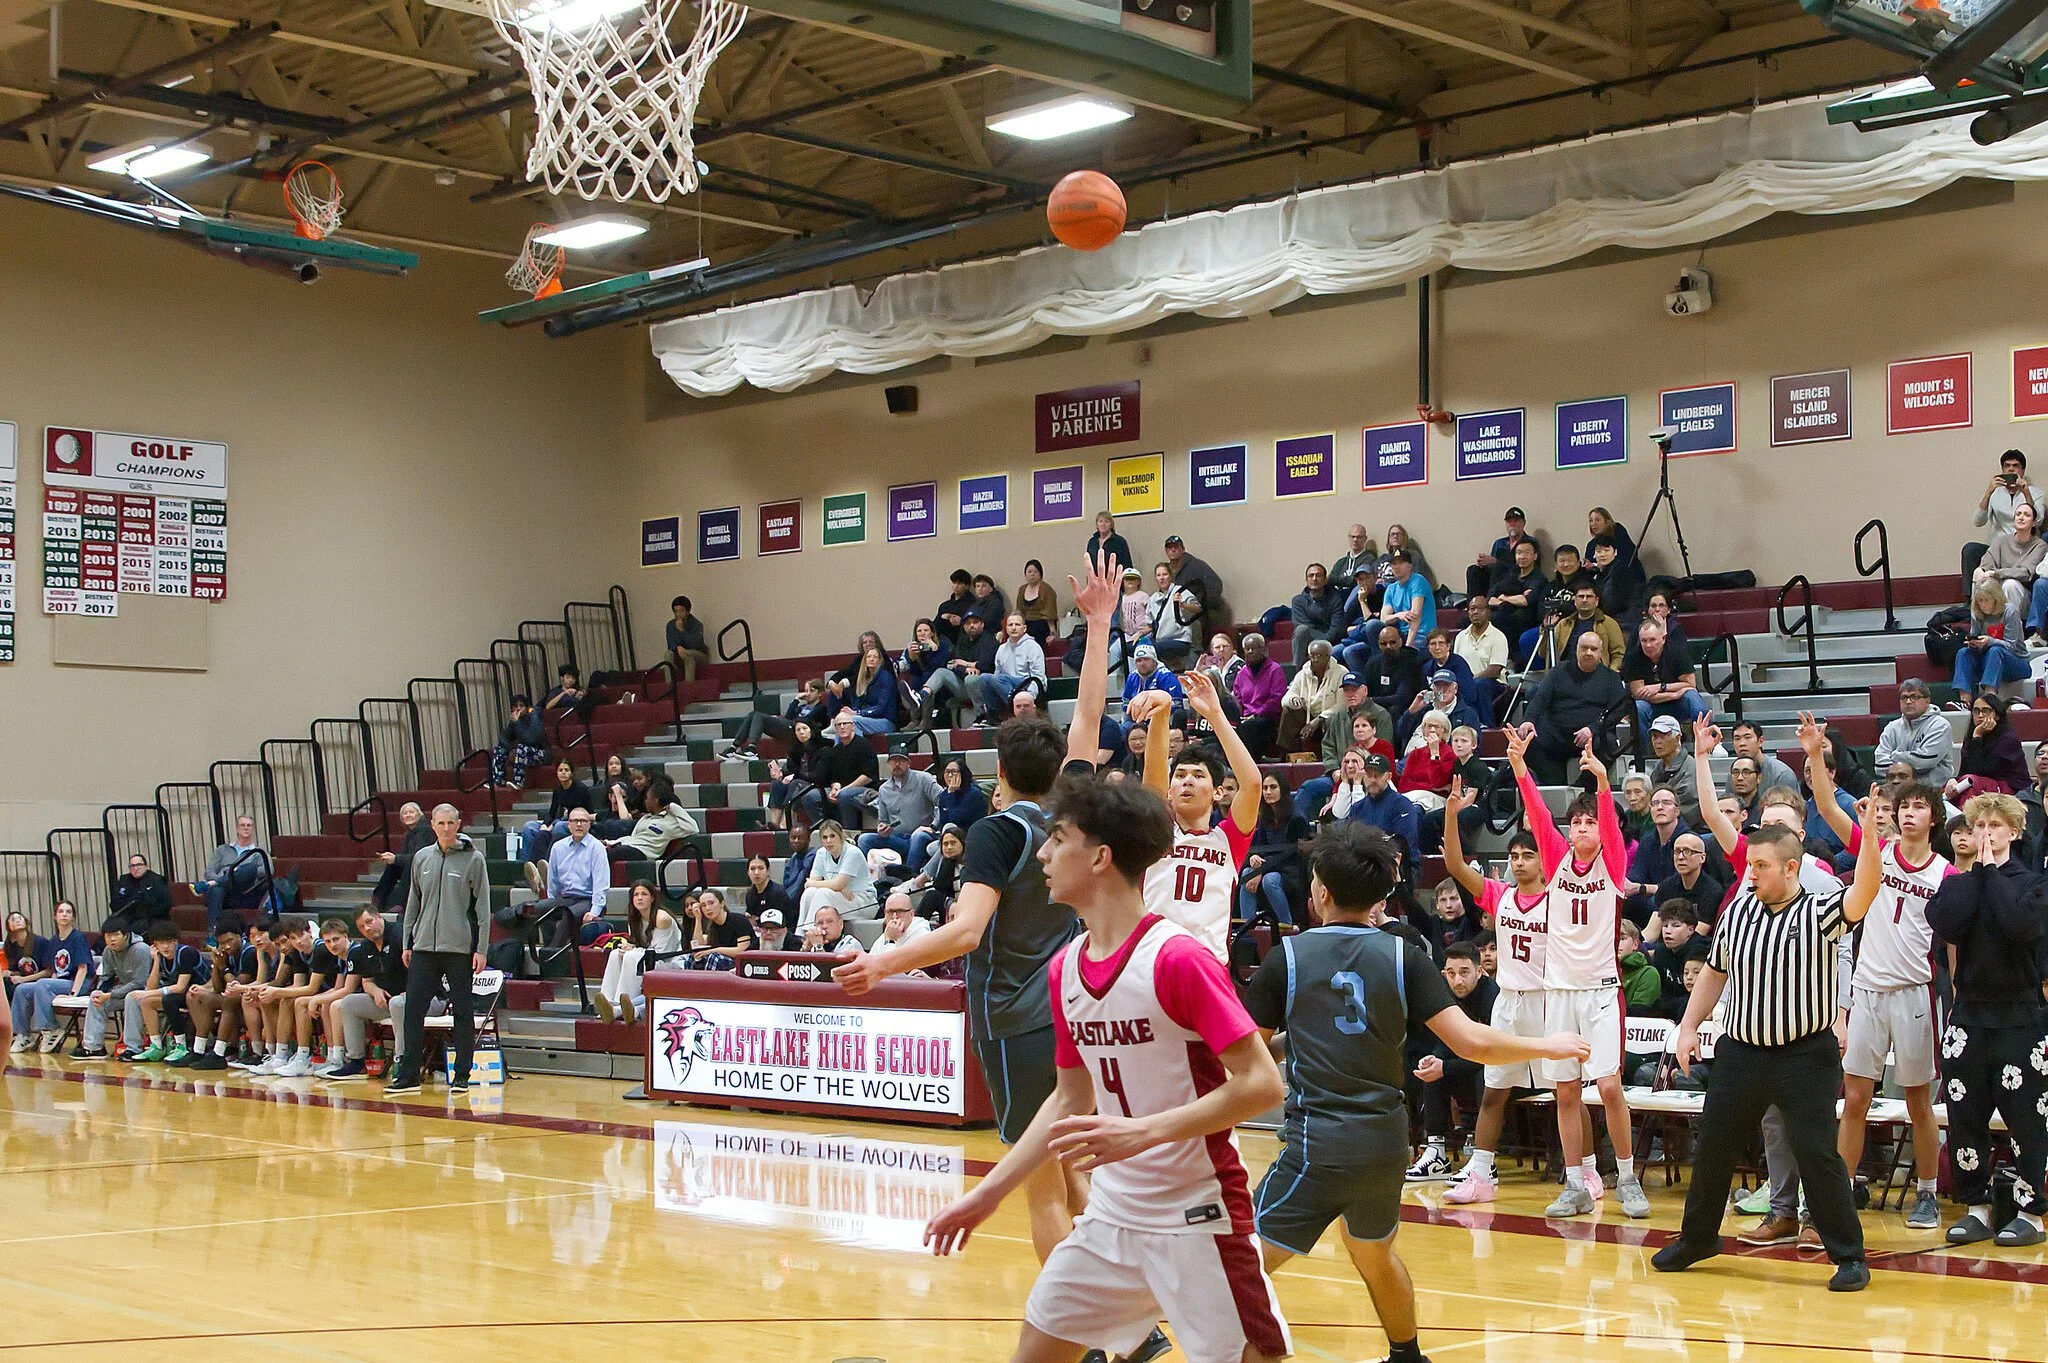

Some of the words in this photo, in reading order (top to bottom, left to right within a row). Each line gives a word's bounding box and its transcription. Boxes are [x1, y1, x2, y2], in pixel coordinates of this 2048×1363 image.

[1790, 386, 1830, 401] MERCER
[1904, 381, 1940, 395] MOUNT
[1943, 378, 1954, 390] SI
[1792, 400, 1828, 414] ISLAND
[1903, 392, 1955, 409] WILDCATS
[1051, 397, 1121, 419] VISITING
[1672, 403, 1723, 420] LINDBERGH
[1052, 414, 1122, 438] PARENTS
[1573, 419, 1609, 433] LIBERTY
[1680, 418, 1715, 432] EAGLES
[1783, 413, 1838, 429] ISLANDERS
[1479, 425, 1501, 438] LAKE
[1463, 436, 1518, 453] WASHINGTON
[1570, 432, 1612, 447] PATRIOTS
[130, 441, 193, 461] GOLF
[1378, 441, 1411, 455] JUANITA
[1285, 452, 1323, 467] ISSAQUAH
[1379, 453, 1410, 467] RAVENS
[1465, 449, 1516, 465] KANGAROOS
[116, 463, 206, 480] CHAMPIONS
[1198, 462, 1238, 477] INTERLAKE
[1290, 465, 1319, 478] EAGLES
[128, 482, 153, 491] GIRLS
[1116, 472, 1155, 487] INGLEMOOR
[1205, 475, 1231, 488] SAINTS
[972, 491, 994, 502] HAZEN
[1122, 485, 1149, 497] VIKINGS
[1044, 492, 1071, 505] PIRATES
[47, 500, 78, 512] 1997
[84, 503, 116, 516] 2000
[123, 506, 152, 519] 2001
[159, 510, 188, 521] 2002
[195, 513, 224, 524] 2007
[766, 516, 794, 528] EASTLAKE
[47, 526, 77, 537] 2013
[84, 529, 116, 541] 2013
[121, 531, 152, 543] 2014
[158, 536, 187, 546] 2014
[195, 538, 223, 548] 2014
[46, 551, 78, 563] 2014
[84, 554, 116, 566] 2015
[122, 557, 151, 569] 2015
[159, 560, 188, 571] 2015
[194, 562, 224, 573] 2015
[46, 576, 78, 588] 2016
[84, 578, 116, 590] 2016
[121, 581, 151, 593] 2016
[158, 583, 187, 594] 2016
[194, 587, 224, 598] 2017
[48, 602, 77, 612] 2017
[85, 604, 114, 614] 2017
[1174, 864, 1207, 903] 10
[1557, 878, 1606, 894] EASTLAKE
[1571, 898, 1588, 925] 11
[1893, 896, 1905, 924] 1
[1511, 934, 1532, 963] 15
[788, 965, 811, 979] POSS
[1330, 971, 1368, 1035] 3
[794, 1012, 846, 1027] WELCOME
[850, 1015, 863, 1027] TO
[1068, 1018, 1154, 1046] EASTLAKE
[711, 1025, 810, 1069] EASTLAKE
[817, 1030, 867, 1073] HIGH
[875, 1033, 956, 1079] SCHOOL
[714, 1069, 774, 1091] HOME
[780, 1073, 807, 1093] OF
[813, 1075, 854, 1097] THE
[861, 1079, 950, 1105] WOLVES
[1099, 1057, 1132, 1118] 4
